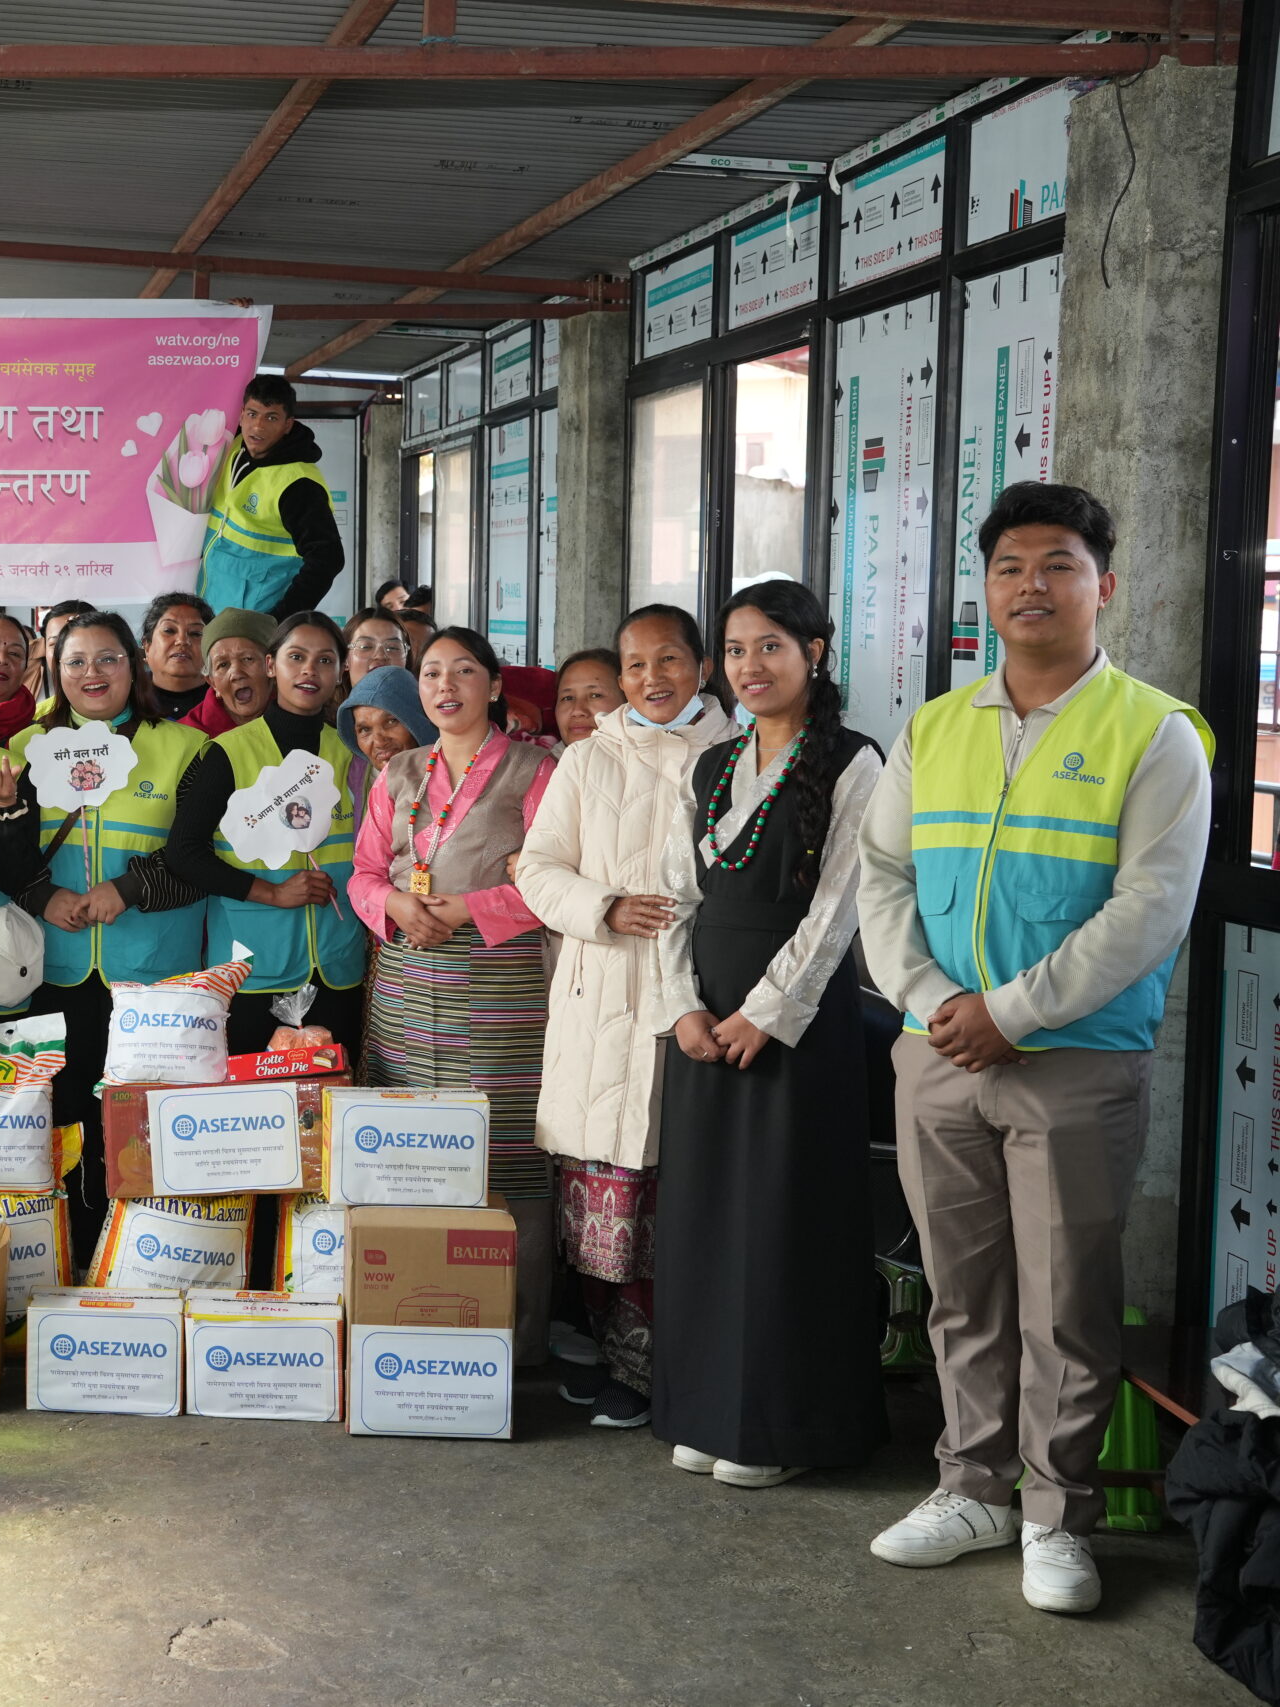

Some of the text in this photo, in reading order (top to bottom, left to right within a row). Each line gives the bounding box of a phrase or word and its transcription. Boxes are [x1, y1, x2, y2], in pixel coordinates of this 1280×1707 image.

[711, 158, 731, 166] eco
[914, 228, 943, 249] THIS SIDE
[860, 247, 895, 269] THIS SIDE UP
[155, 333, 240, 349] watv.org/ne
[148, 355, 240, 368] asezwao.org
[63, 362, 96, 382] समूह
[998, 357, 1007, 410] PANEL
[1043, 369, 1052, 397] UP
[850, 385, 858, 419] HIGH
[27, 405, 105, 441] तथा
[905, 393, 913, 436] THIS
[1041, 402, 1051, 449] SIDE
[849, 424, 857, 483] QUALITY
[975, 425, 983, 501] CHOICE
[994, 415, 1004, 500] OMPOSITE
[903, 487, 910, 511] UP
[959, 425, 977, 576] PAANEL
[847, 487, 855, 569] ALUMINIUM
[8, 561, 49, 577] जनवरी
[75, 560, 115, 577] तारिख
[864, 515, 879, 649] PAANEL
[899, 573, 907, 615] THIS
[843, 572, 853, 654] COMPOSITE
[896, 666, 903, 690] UP
[73, 748, 90, 759] बल
[1052, 770, 1106, 786] ASEZWAO
[133, 791, 169, 801] ASEZWAO
[283, 783, 301, 799] माया
[139, 1012, 218, 1032] ASEZWAO
[255, 1055, 285, 1066] Lotte
[255, 1062, 309, 1076] Choco Pie
[198, 1114, 285, 1134] ASEZWAO
[382, 1132, 475, 1150] ASEZWAO
[205, 1202, 248, 1222] Laxmi
[1267, 1228, 1277, 1257] UP
[161, 1243, 236, 1267] ASEZWAO
[453, 1247, 509, 1261] BALTRA
[363, 1272, 395, 1282] WOW
[77, 1340, 168, 1359] ASEZWAO
[232, 1351, 325, 1368] ASEZWAO
[402, 1359, 499, 1379] ASEZWAO
